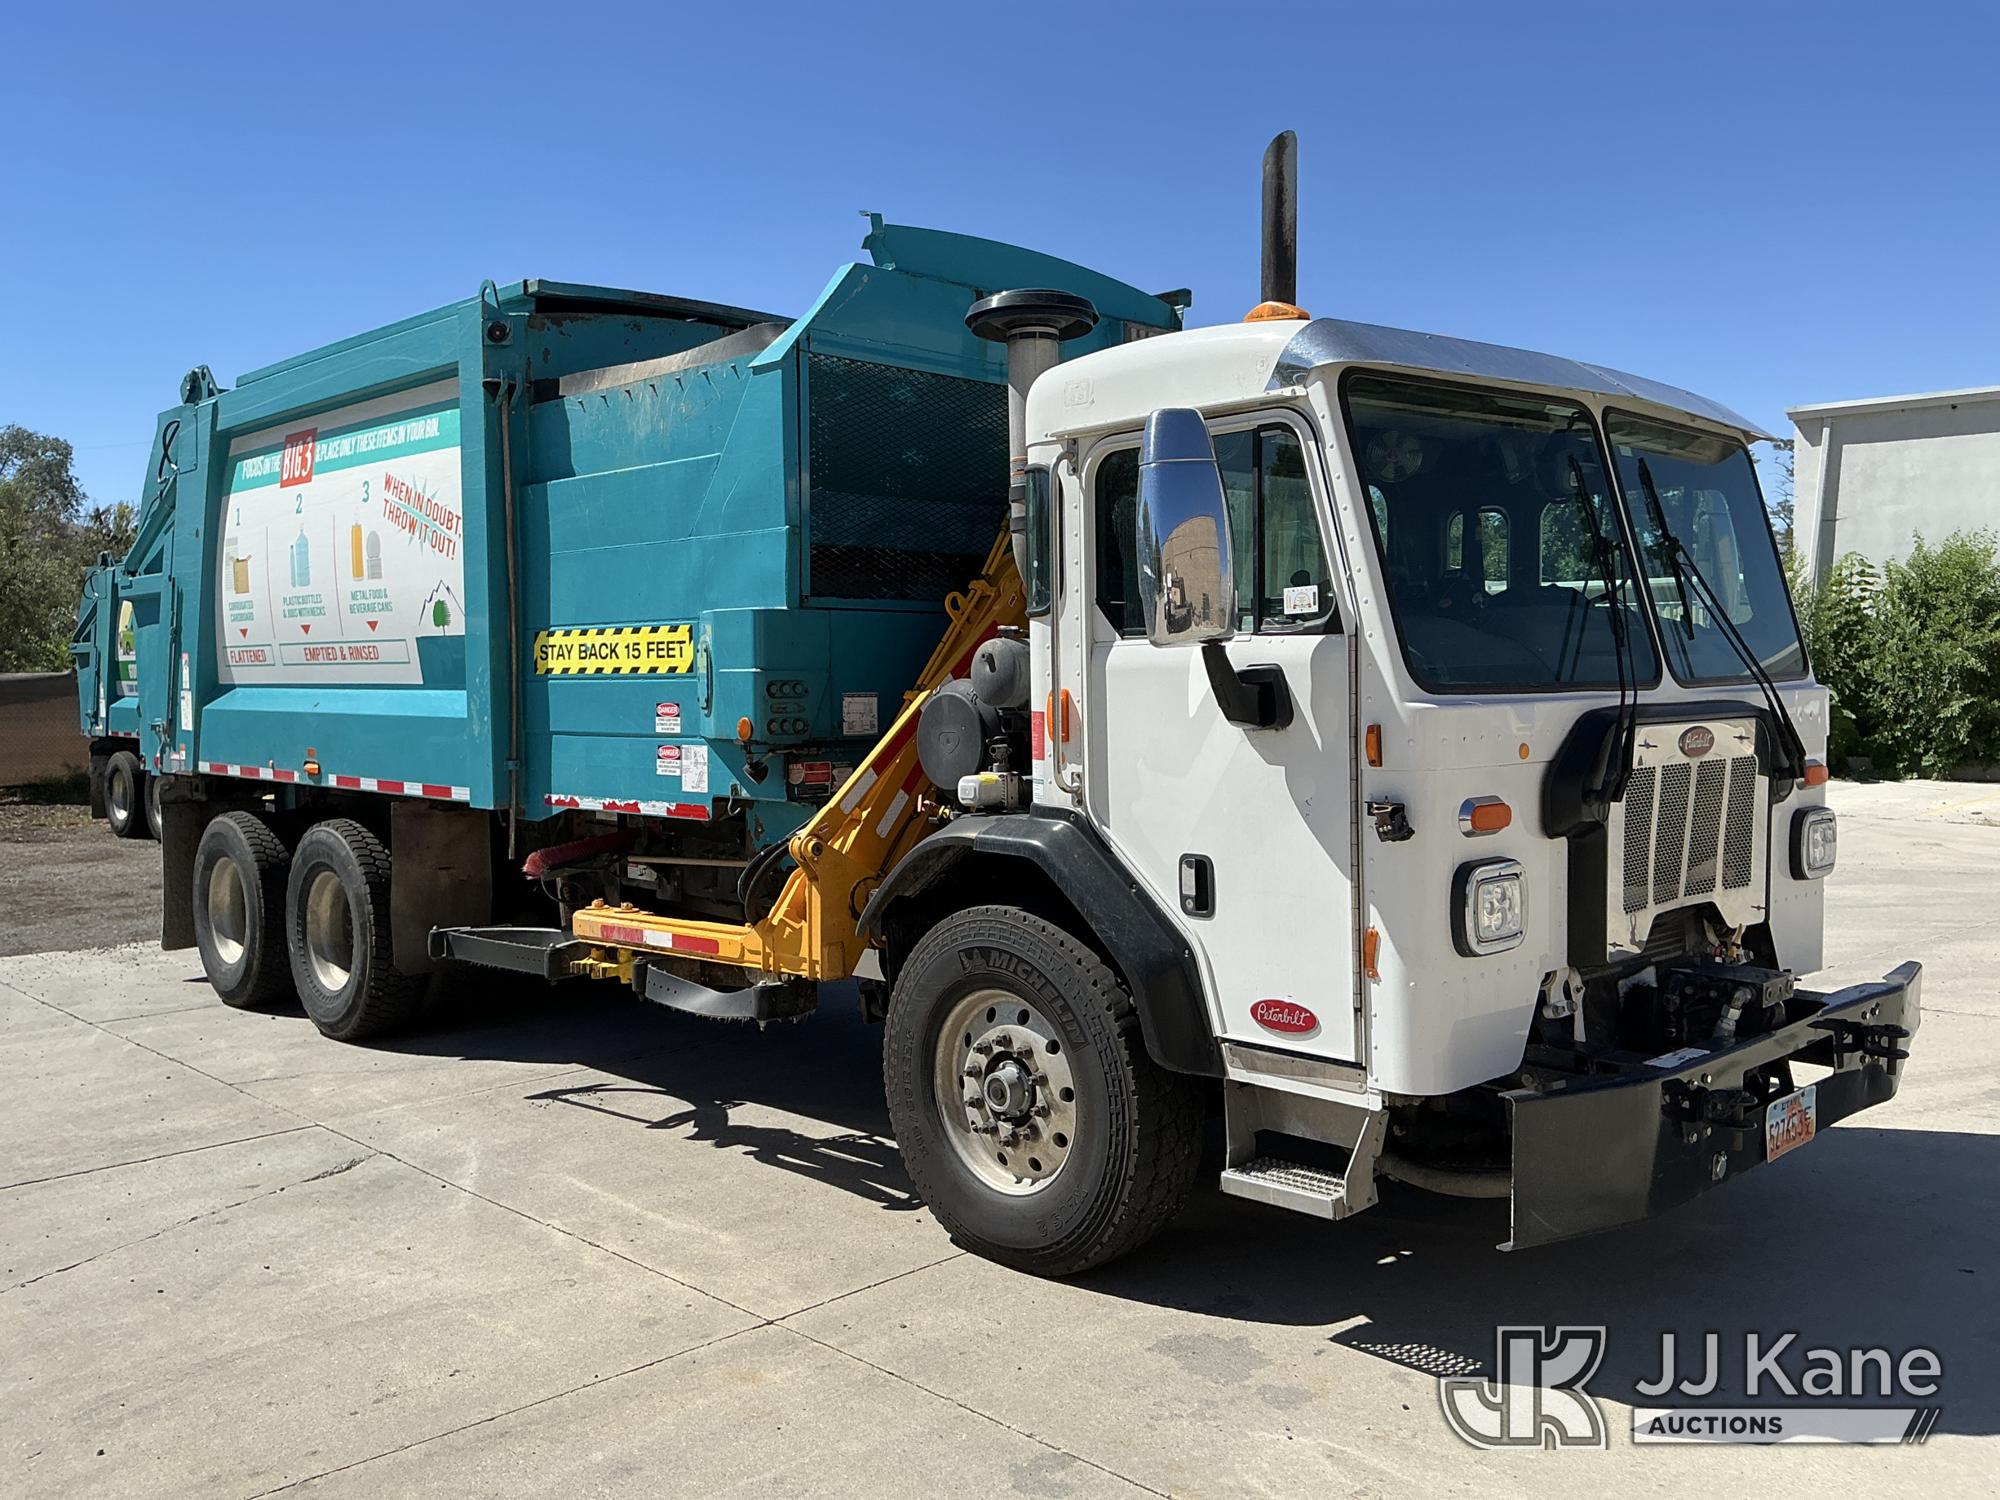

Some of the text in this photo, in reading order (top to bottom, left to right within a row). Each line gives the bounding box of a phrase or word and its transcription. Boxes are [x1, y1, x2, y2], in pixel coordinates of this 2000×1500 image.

[283, 440, 304, 480] BIG
[301, 436, 313, 477] 3
[362, 480, 370, 503] 3
[384, 472, 412, 505] WHEN
[413, 490, 424, 512] IN
[295, 493, 303, 514] 2
[236, 507, 241, 526] 1
[383, 498, 456, 560] THROW IT OUT!
[230, 649, 267, 664] FLATTENED
[304, 646, 380, 661] EMPTIED & RINSED
[539, 640, 686, 661] STAY BACK 15 FEET
[659, 705, 678, 714] DANGER
[660, 748, 679, 757] DANGER
[988, 948, 1082, 1038] MICHELIN
[1257, 1002, 1310, 1026] Peterbilt
